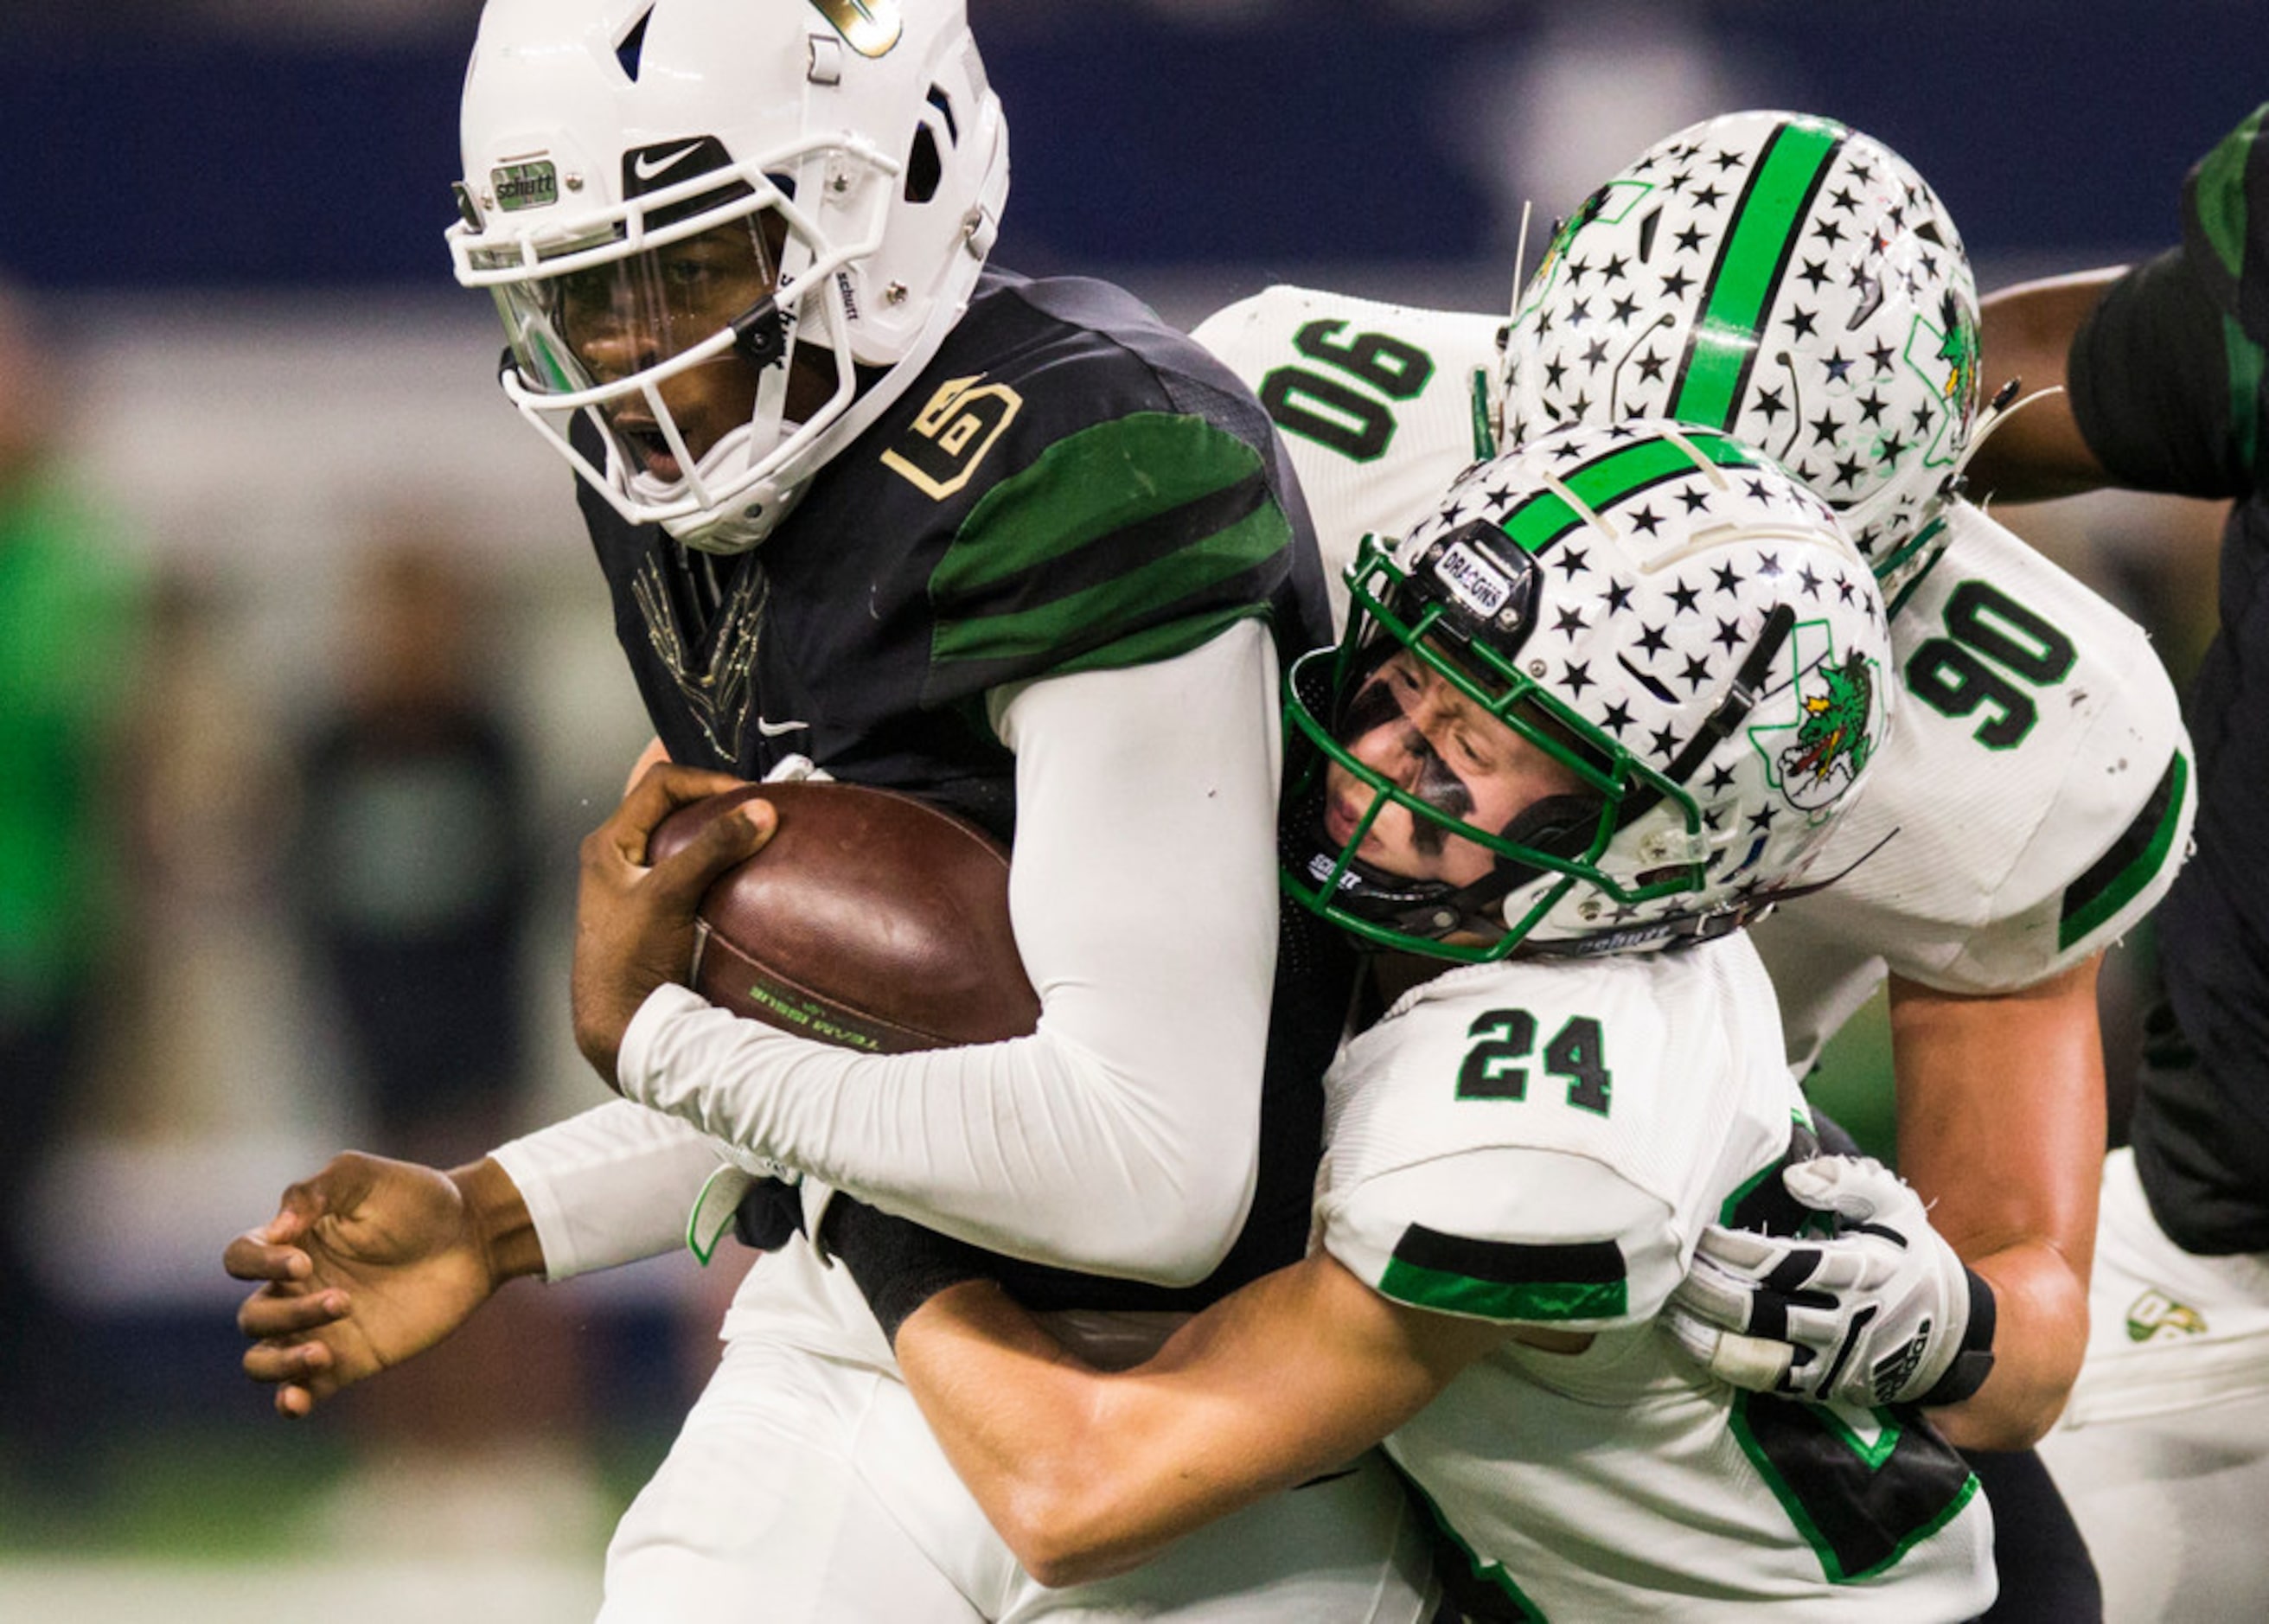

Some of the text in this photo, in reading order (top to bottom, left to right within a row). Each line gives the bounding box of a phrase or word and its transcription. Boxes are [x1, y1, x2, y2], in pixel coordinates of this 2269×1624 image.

[497, 174, 554, 201] schutt
[835, 271, 859, 321] schutt
[879, 372, 1024, 502] 5
[1257, 318, 1436, 465] 90
[1904, 579, 2079, 751] 90
[1454, 1007, 1613, 1119] 24
